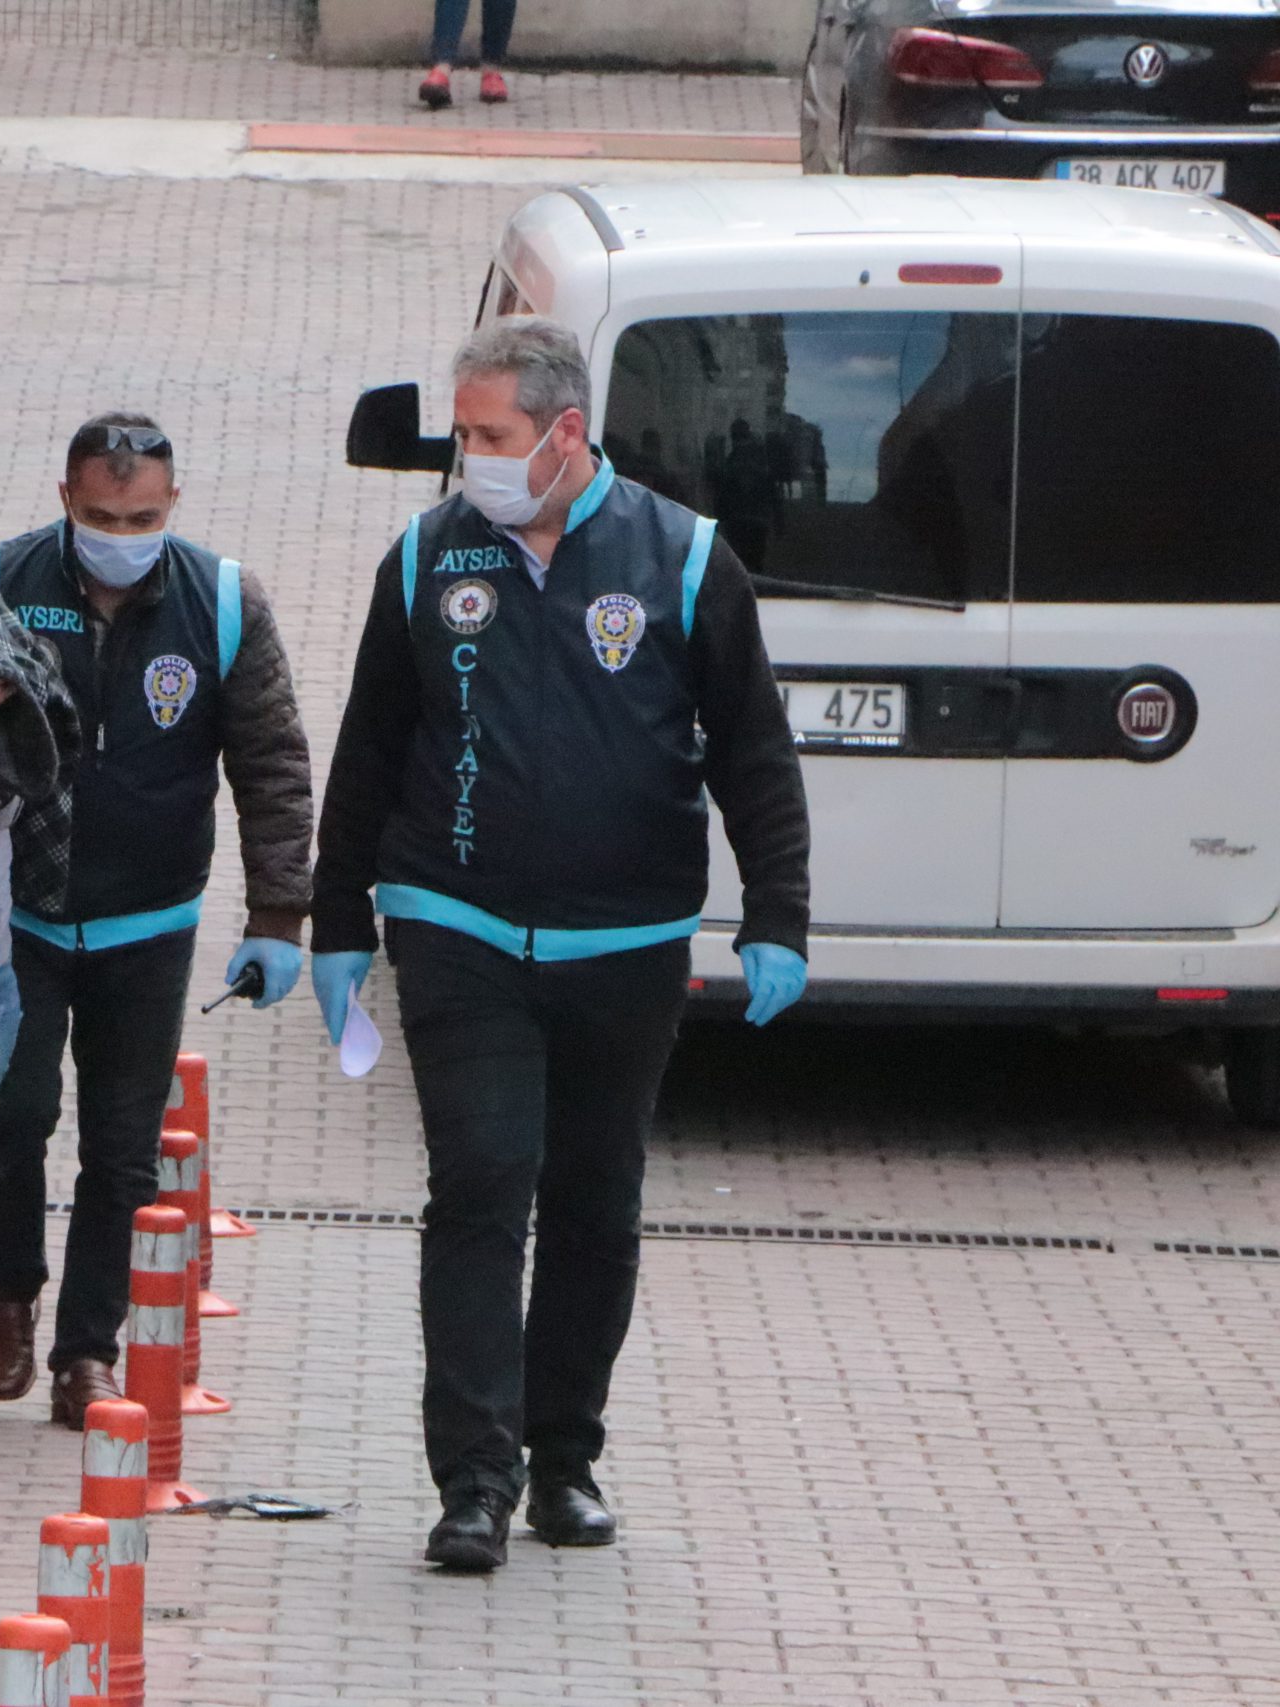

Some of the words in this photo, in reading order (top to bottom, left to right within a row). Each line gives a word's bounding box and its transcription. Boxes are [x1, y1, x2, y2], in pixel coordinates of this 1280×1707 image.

[1116, 164, 1158, 189] ACK
[1172, 165, 1216, 190] 407
[824, 688, 892, 728] 475
[1131, 701, 1166, 727] FIAT
